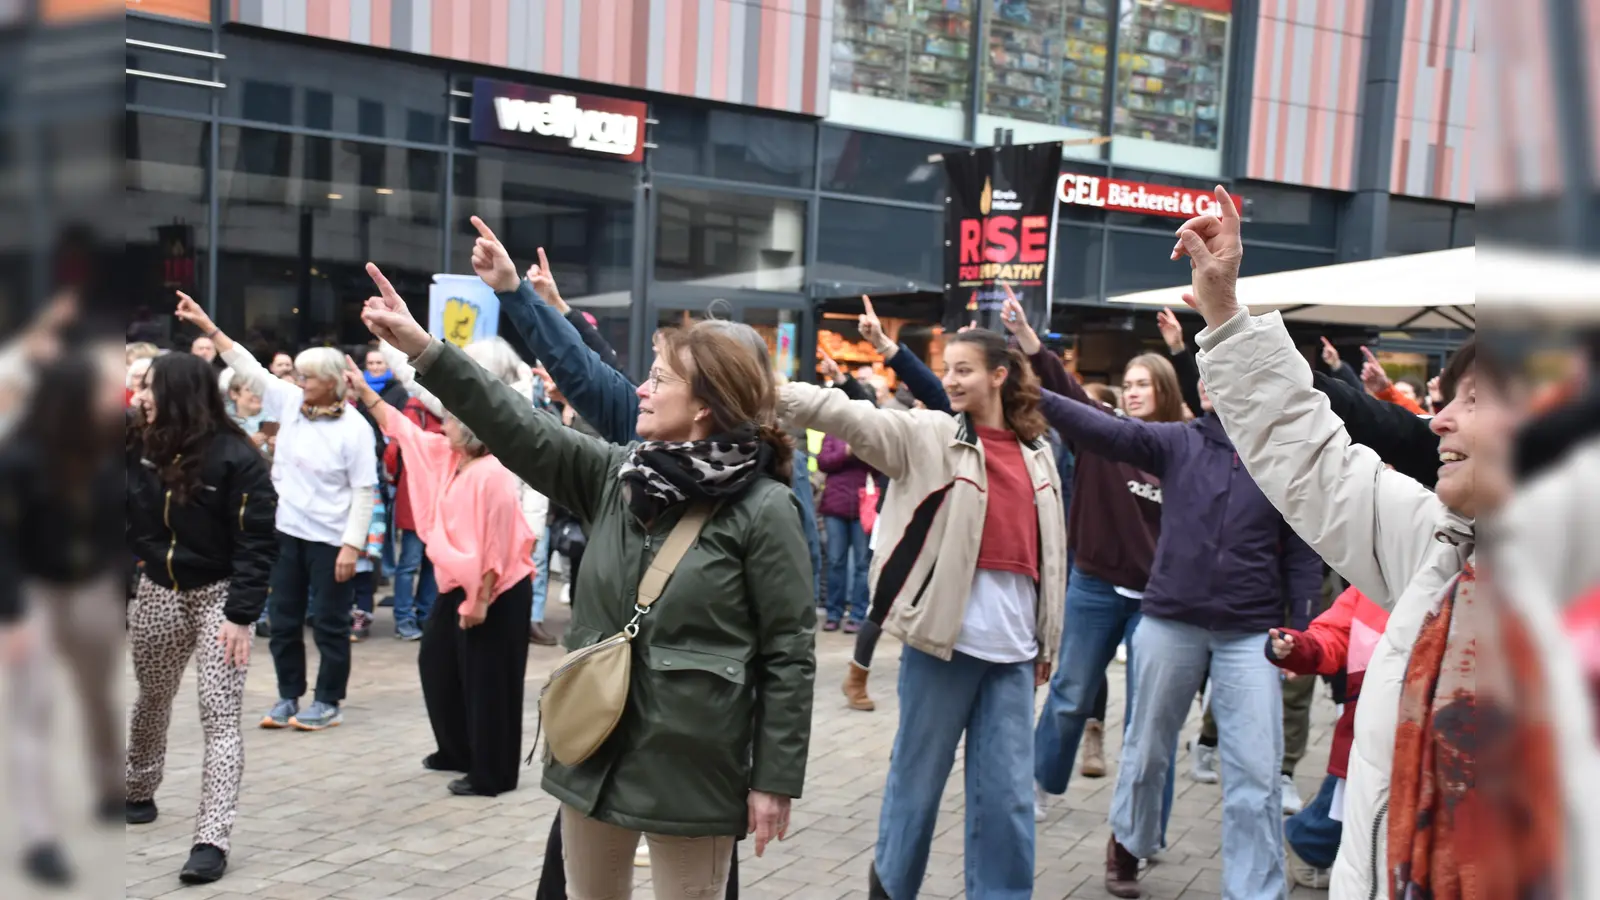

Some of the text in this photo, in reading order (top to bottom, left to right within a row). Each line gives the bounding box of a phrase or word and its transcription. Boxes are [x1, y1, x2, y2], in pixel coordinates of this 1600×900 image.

[494, 94, 638, 155] wellyou
[1107, 183, 1180, 213] Bäckerei
[1180, 193, 1194, 214] &
